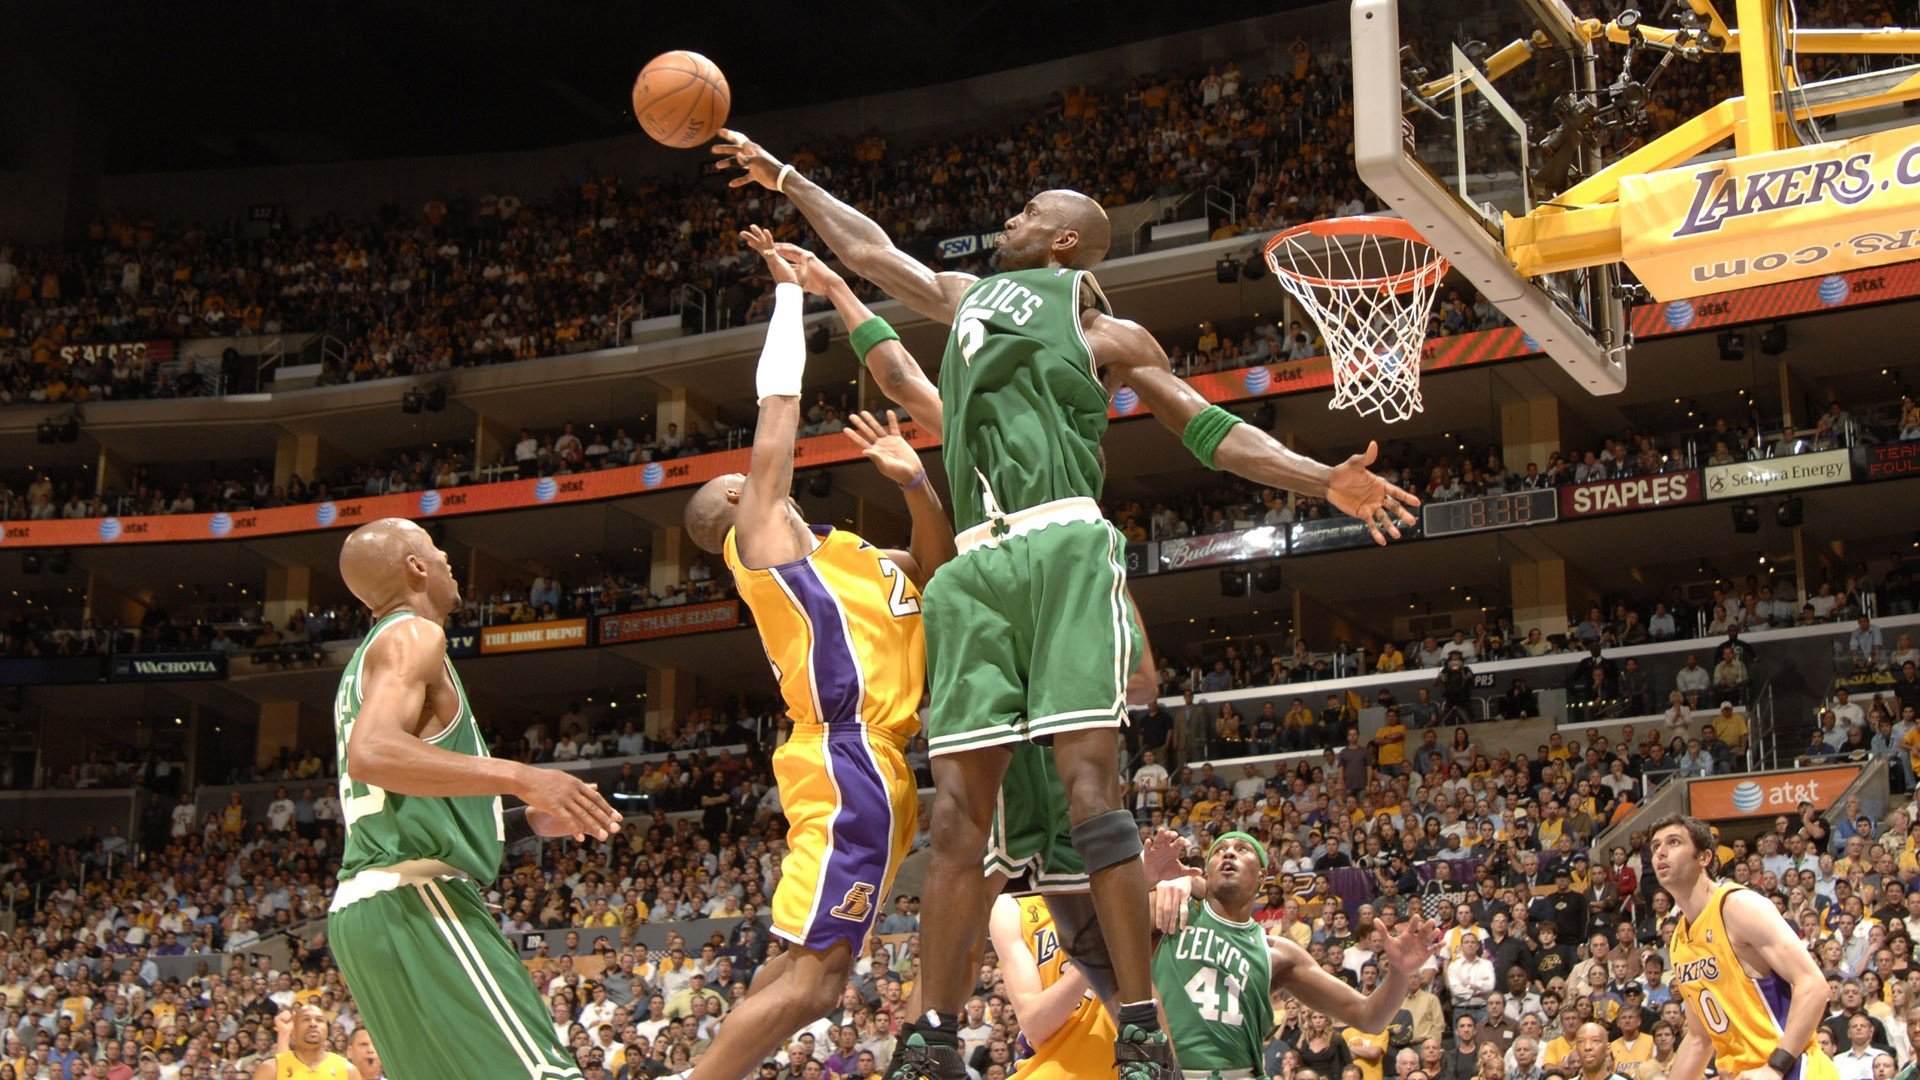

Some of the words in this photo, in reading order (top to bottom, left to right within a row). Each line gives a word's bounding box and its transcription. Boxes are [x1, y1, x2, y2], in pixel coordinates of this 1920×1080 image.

[943, 238, 972, 254] FSN
[960, 278, 1044, 326] LTICS
[1731, 469, 1789, 488] Sempra
[1792, 461, 1844, 481] Energy
[1573, 475, 1688, 513] STAPLES
[878, 557, 922, 618] 2
[485, 632, 508, 646] THE
[511, 629, 544, 644] HOME
[546, 626, 585, 641] DEPOT
[134, 661, 217, 674] WACHOVIA
[1769, 779, 1819, 805] at&t
[1176, 926, 1250, 992] CELTICS
[1184, 966, 1244, 1026] 41
